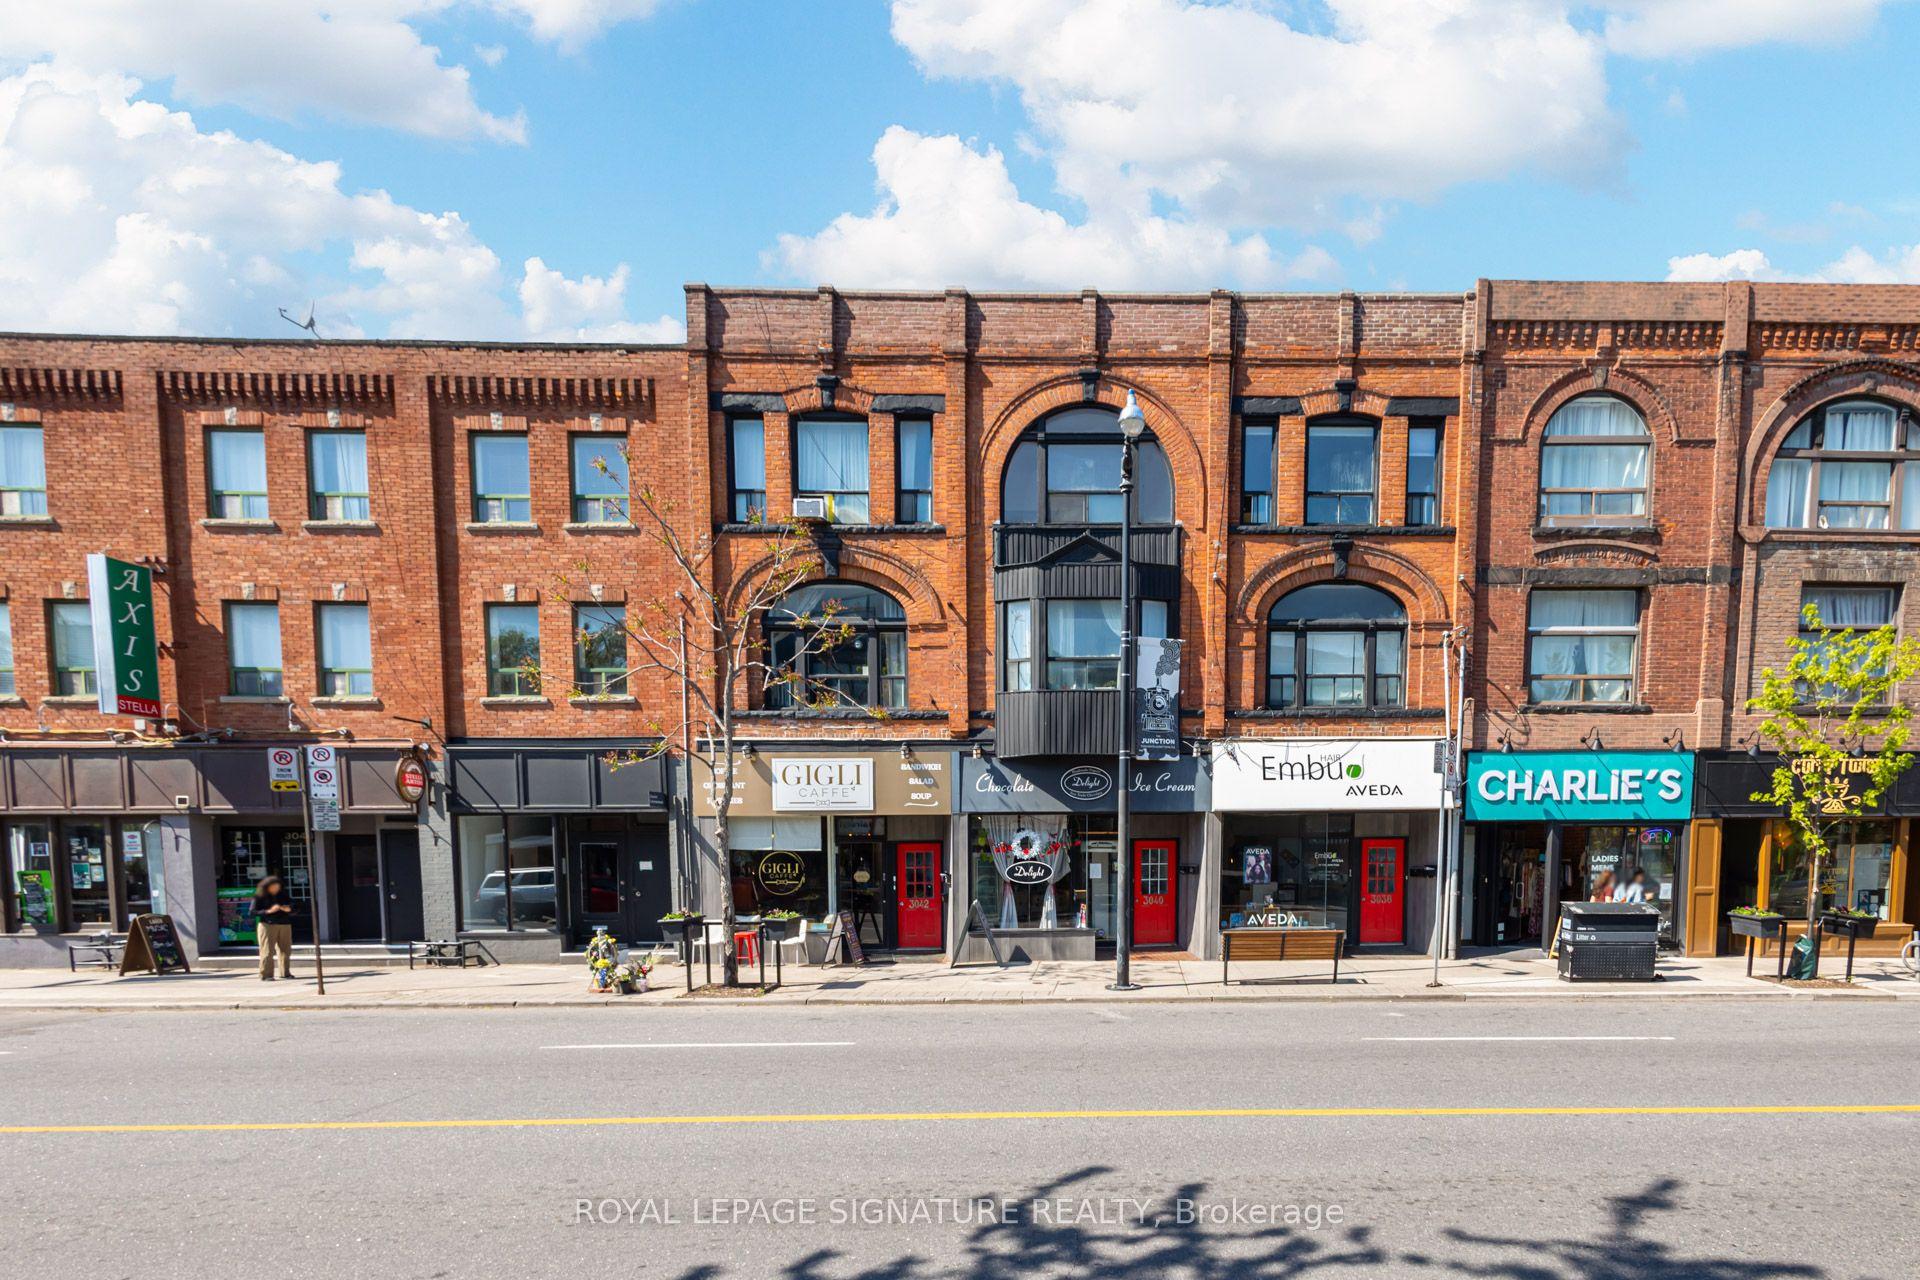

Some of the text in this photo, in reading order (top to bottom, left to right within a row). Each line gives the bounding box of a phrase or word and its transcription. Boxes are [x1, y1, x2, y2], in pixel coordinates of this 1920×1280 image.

[114, 569, 147, 692] AXIS
[119, 699, 158, 715] STELLA
[1320, 754, 1341, 762] HAIR
[782, 764, 862, 786] GIGLI
[975, 773, 1034, 793] Chocolate
[1072, 776, 1100, 789] Delight
[1128, 773, 1195, 792] Ice Cream
[1346, 785, 1403, 796] AVEDA
[762, 863, 799, 874] GIGLI
[1014, 866, 1045, 879] Delight
[909, 900, 930, 909] 3042
[1143, 896, 1164, 905] 3040
[1247, 914, 1298, 925] AVEDA
